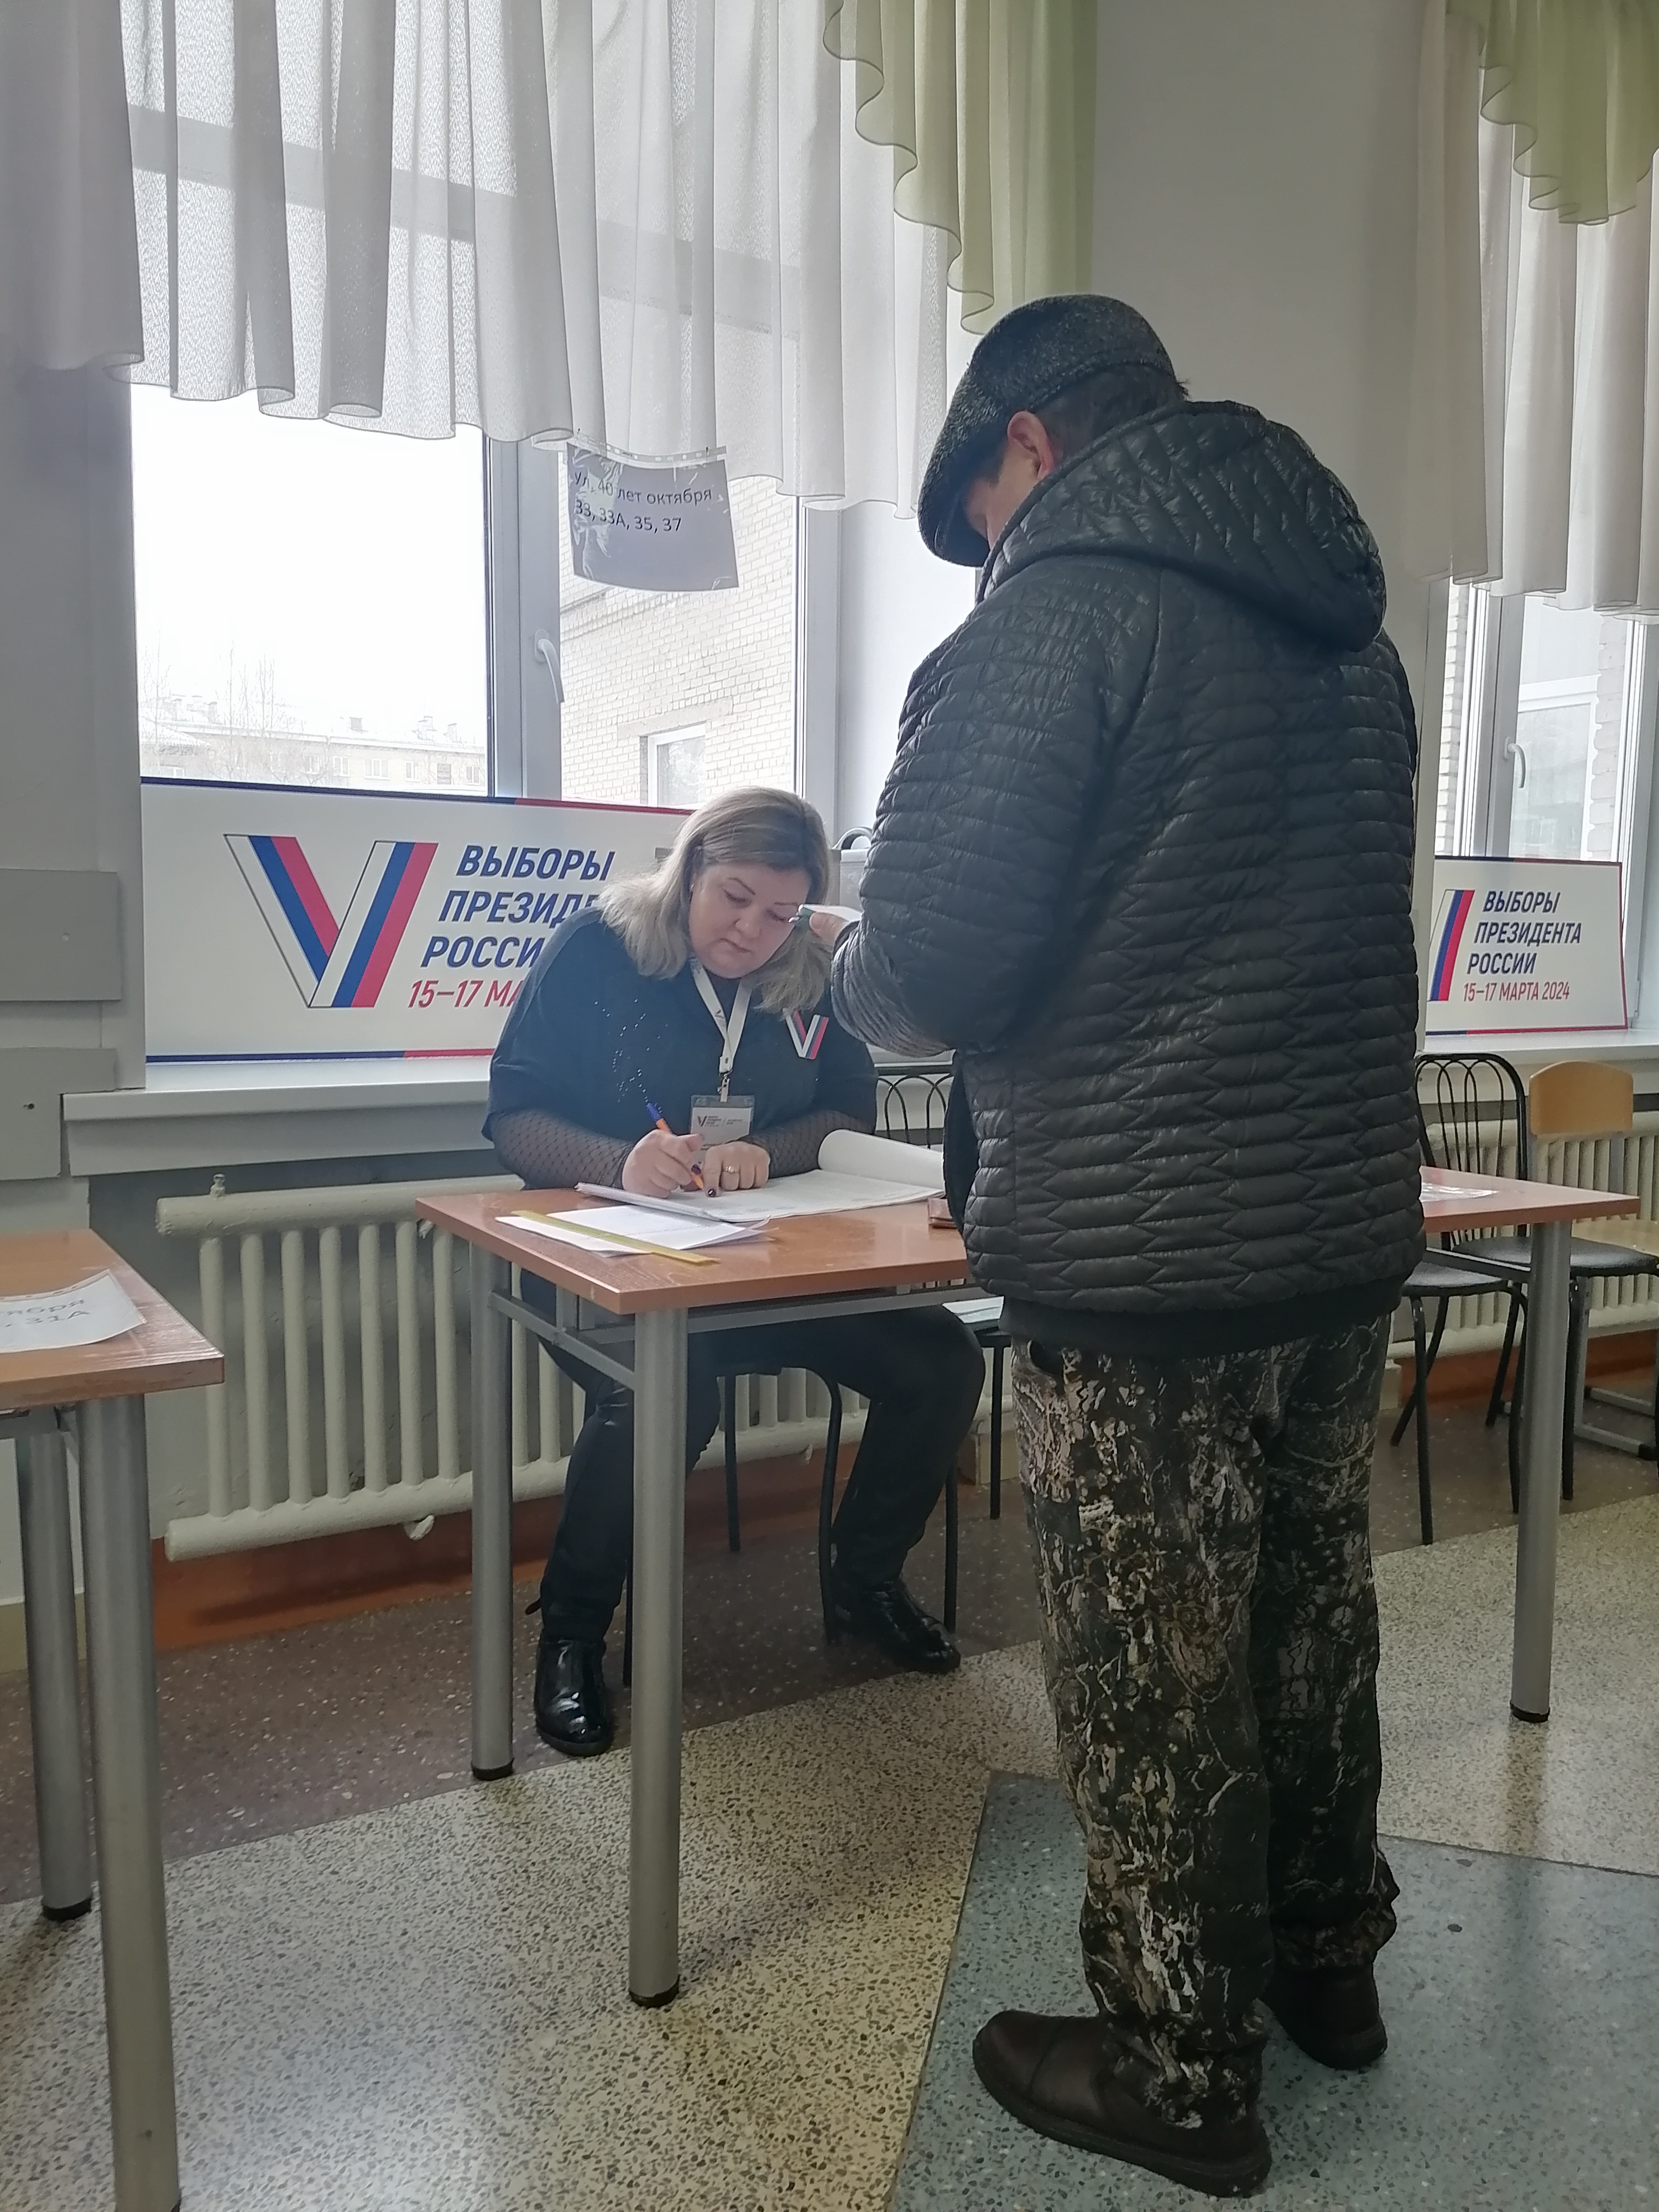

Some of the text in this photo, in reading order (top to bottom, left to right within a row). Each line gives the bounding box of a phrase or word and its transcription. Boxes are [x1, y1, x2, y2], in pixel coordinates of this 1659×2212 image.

[598, 478, 613, 496] 40
[618, 488, 641, 503] лет
[646, 488, 712, 505] октября
[599, 508, 629, 530] 33А,
[634, 516, 657, 533] 35,
[663, 518, 681, 531] 37
[456, 844, 614, 881] ВЫБОРЫ
[1483, 891, 1561, 912] ВЫБОРЫ
[1473, 922, 1582, 947] ПРЕЗИДЕНТА
[1467, 953, 1537, 974] РОССИИ
[1498, 982, 1538, 1001] МАРТА
[1541, 982, 1569, 1000] 2024
